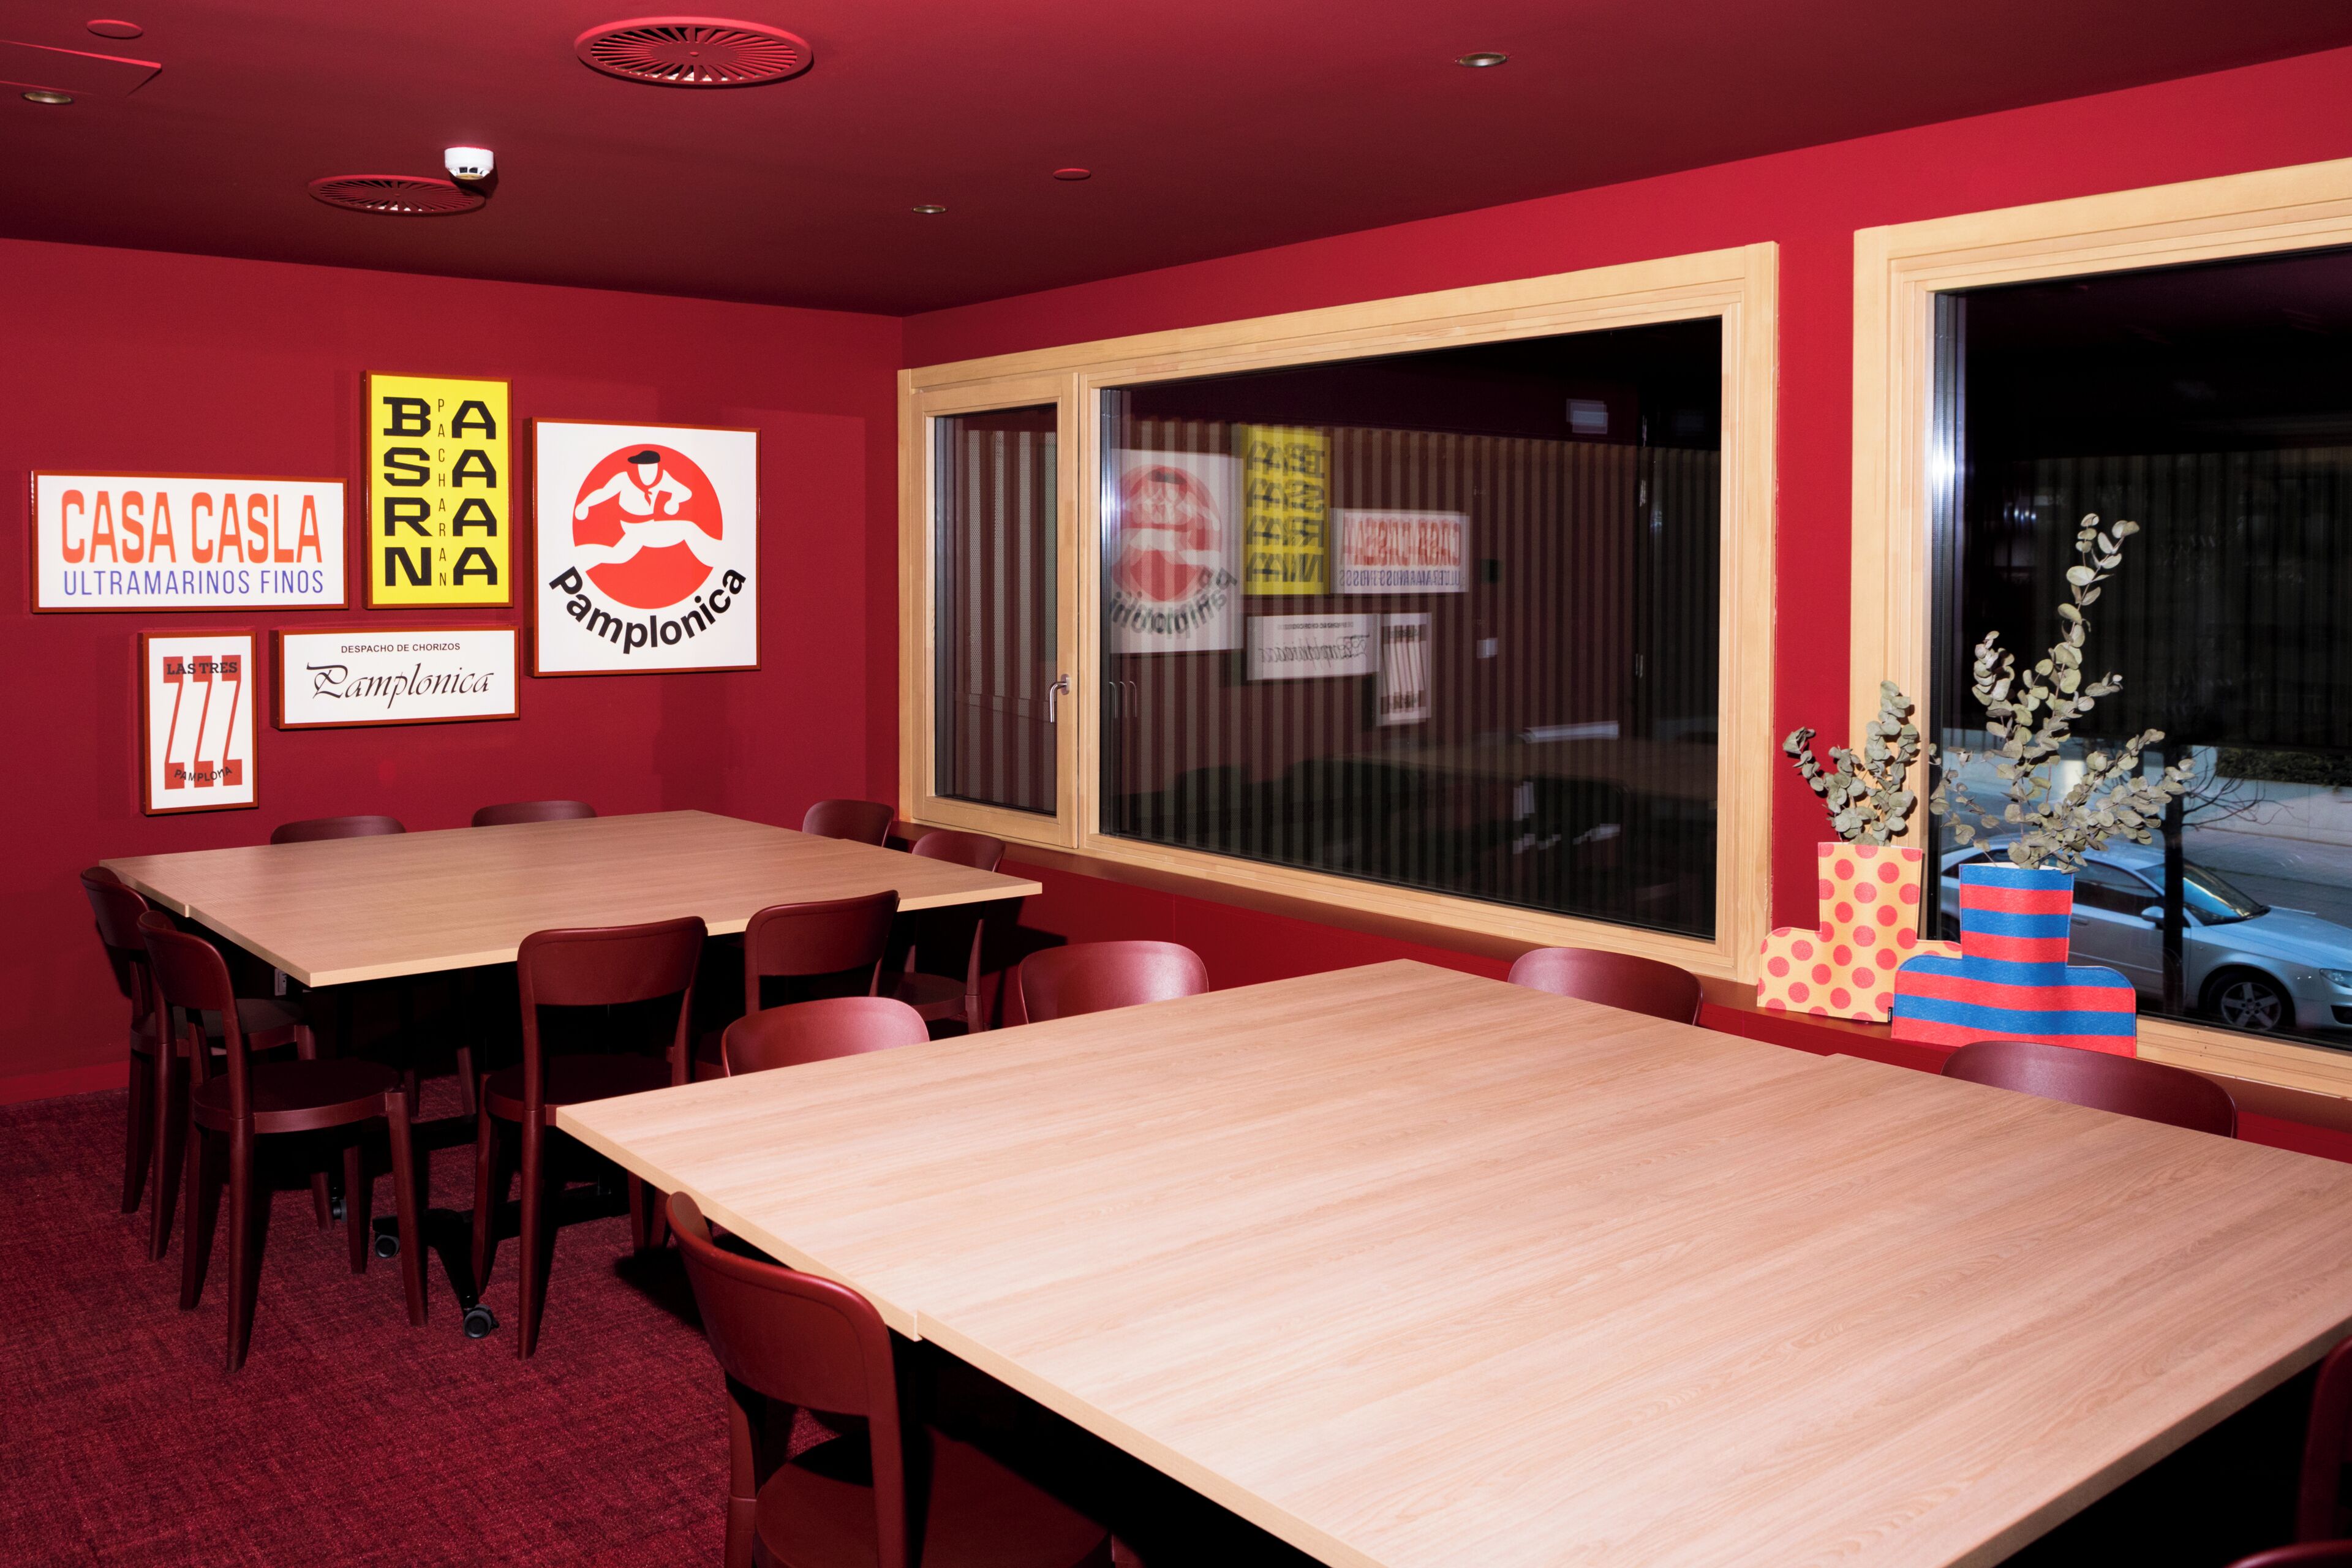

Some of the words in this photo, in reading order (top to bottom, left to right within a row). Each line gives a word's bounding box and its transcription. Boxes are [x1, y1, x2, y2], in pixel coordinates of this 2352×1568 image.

[62, 489, 176, 564] CASA
[192, 492, 322, 564] CASLA
[64, 570, 250, 595] ULTRAMARINOS
[261, 570, 323, 594] FINOS
[549, 566, 746, 654] Pamplonica
[341, 644, 394, 654] DESPACHO
[412, 643, 461, 652] CHORIZOS
[167, 663, 196, 675] LAS
[198, 662, 238, 674] TRES
[306, 662, 494, 709] Pamplonica
